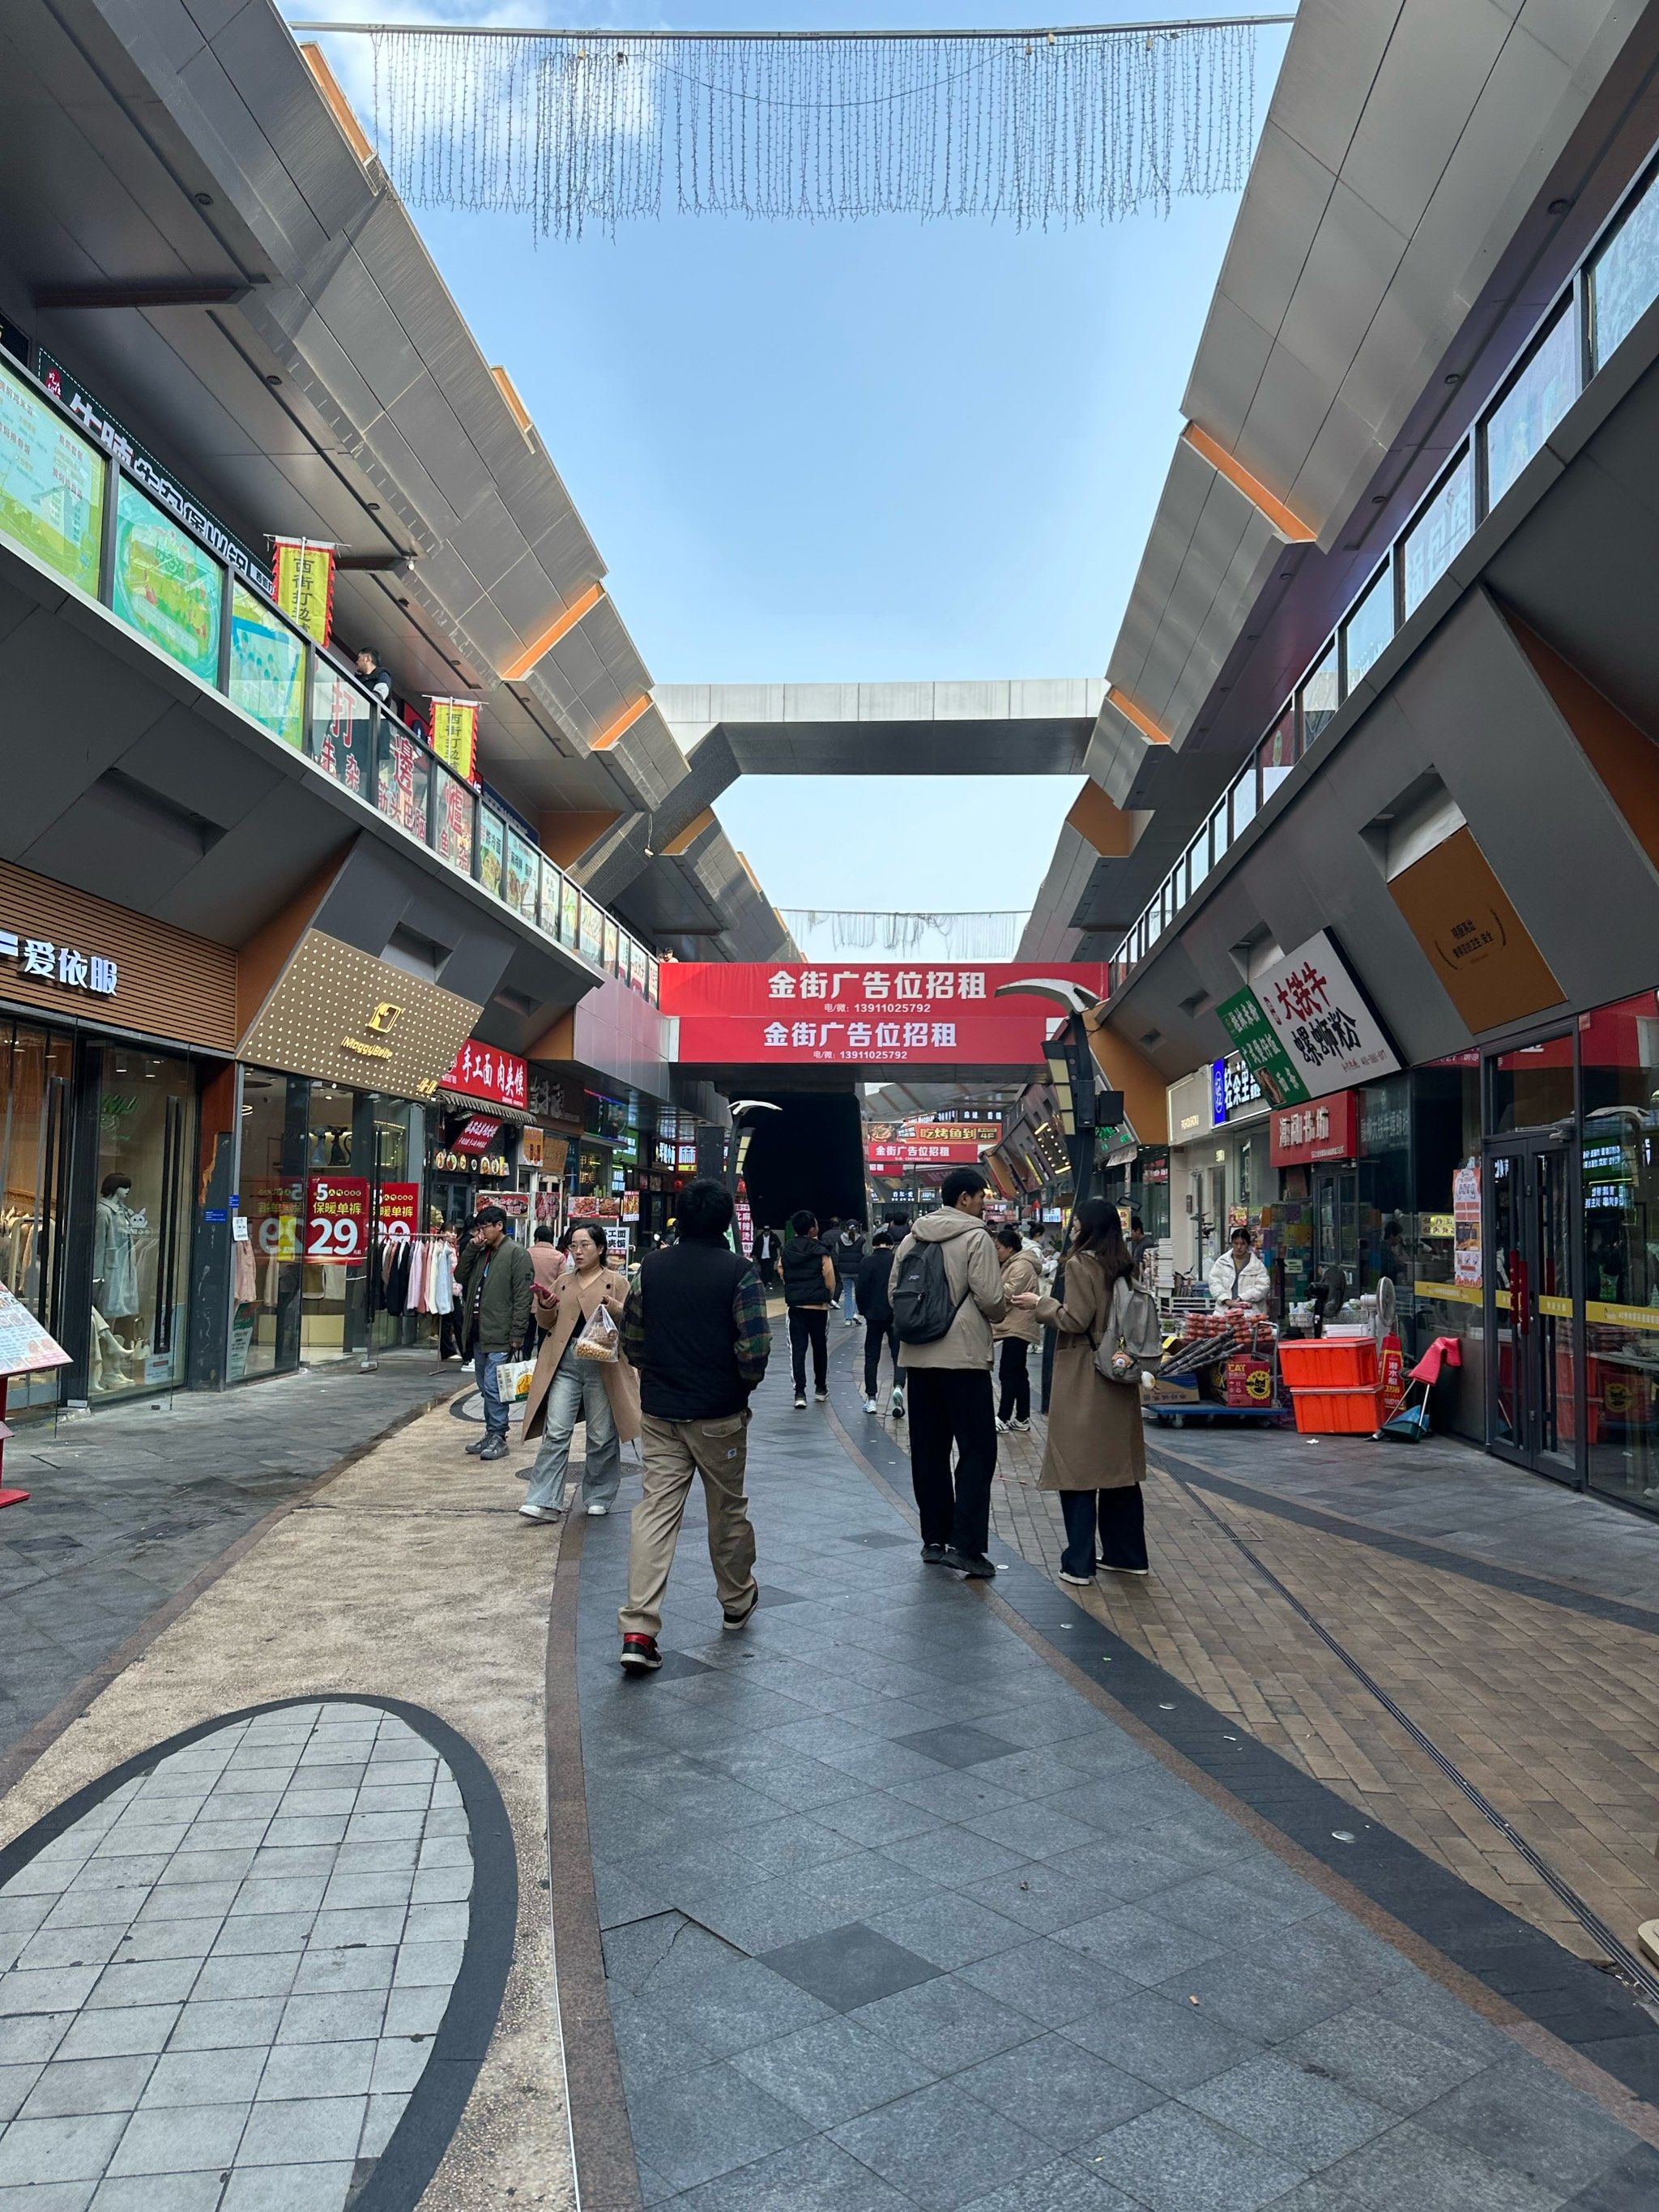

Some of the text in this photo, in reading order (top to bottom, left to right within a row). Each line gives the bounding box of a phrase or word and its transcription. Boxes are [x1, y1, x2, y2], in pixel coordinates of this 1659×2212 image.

[768, 970, 987, 1000] 金街广告位招租
[1274, 961, 1327, 1022] 大铁牛
[854, 1004, 931, 1013] 13911025792
[763, 1021, 957, 1048] 金街广告位招租
[839, 1051, 907, 1059] 13911025792
[919, 1127, 977, 1140] 吃烤鱼到
[876, 1146, 949, 1157] 金街广告位招租
[316, 1183, 328, 1202] 5
[313, 1202, 362, 1215] 保暖单裤
[308, 1217, 358, 1256] 29
[604, 1229, 626, 1238] 工面
[1227, 1364, 1246, 1373] CAT
